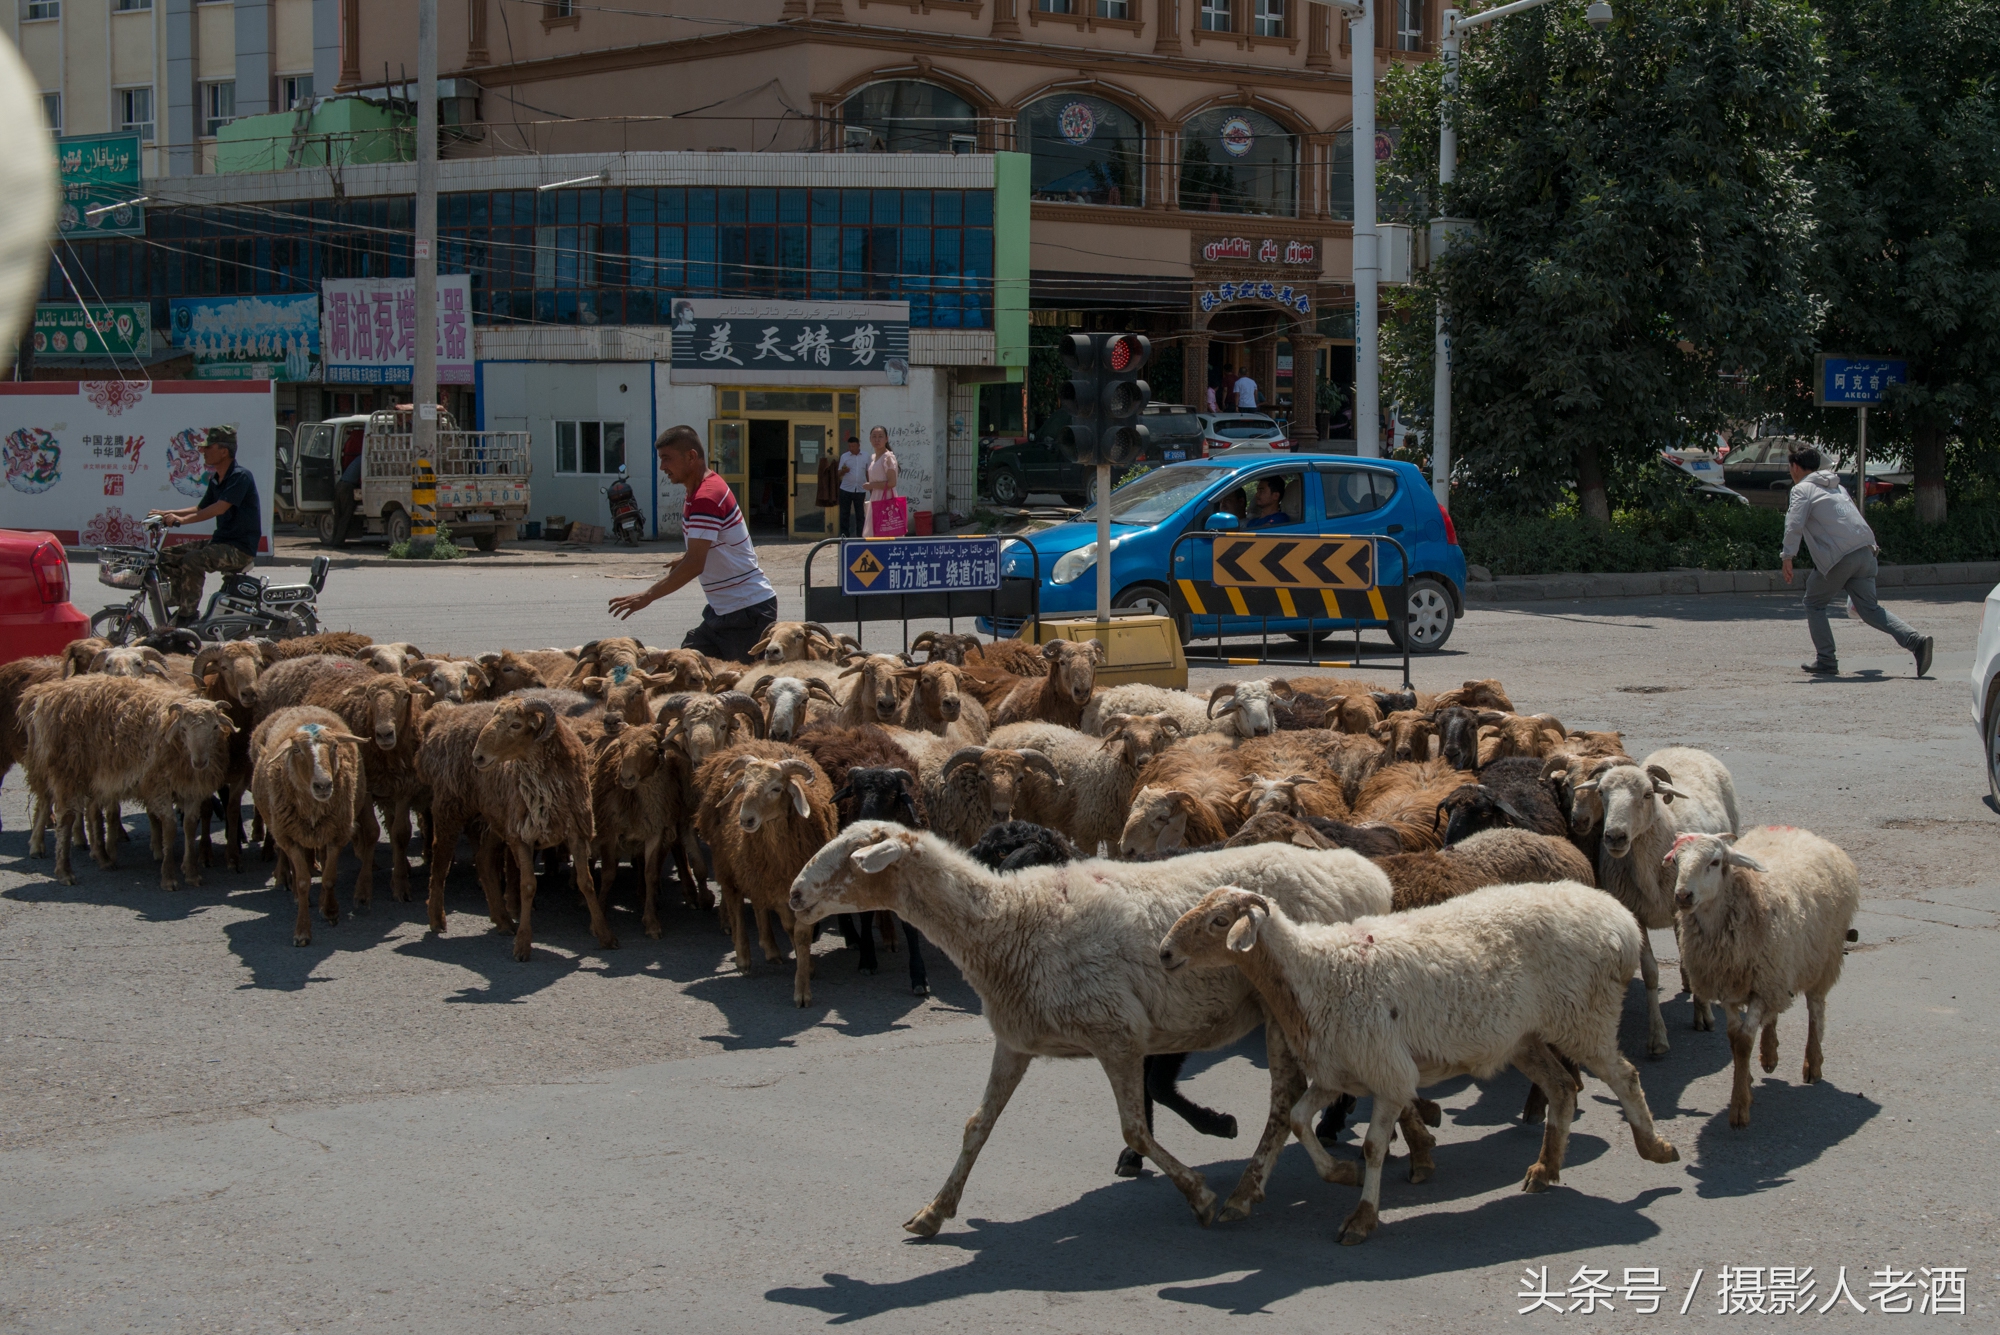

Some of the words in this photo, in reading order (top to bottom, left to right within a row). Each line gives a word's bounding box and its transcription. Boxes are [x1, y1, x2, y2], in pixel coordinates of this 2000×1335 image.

[329, 288, 467, 362] 调油泵增器
[700, 321, 880, 367] 美天精剪
[82, 434, 124, 446] 中国龙腾
[93, 446, 124, 458] 中华圆
[124, 435, 145, 474] 梦
[888, 561, 941, 589] 前方施工
[946, 558, 996, 587] 绕道行驶
